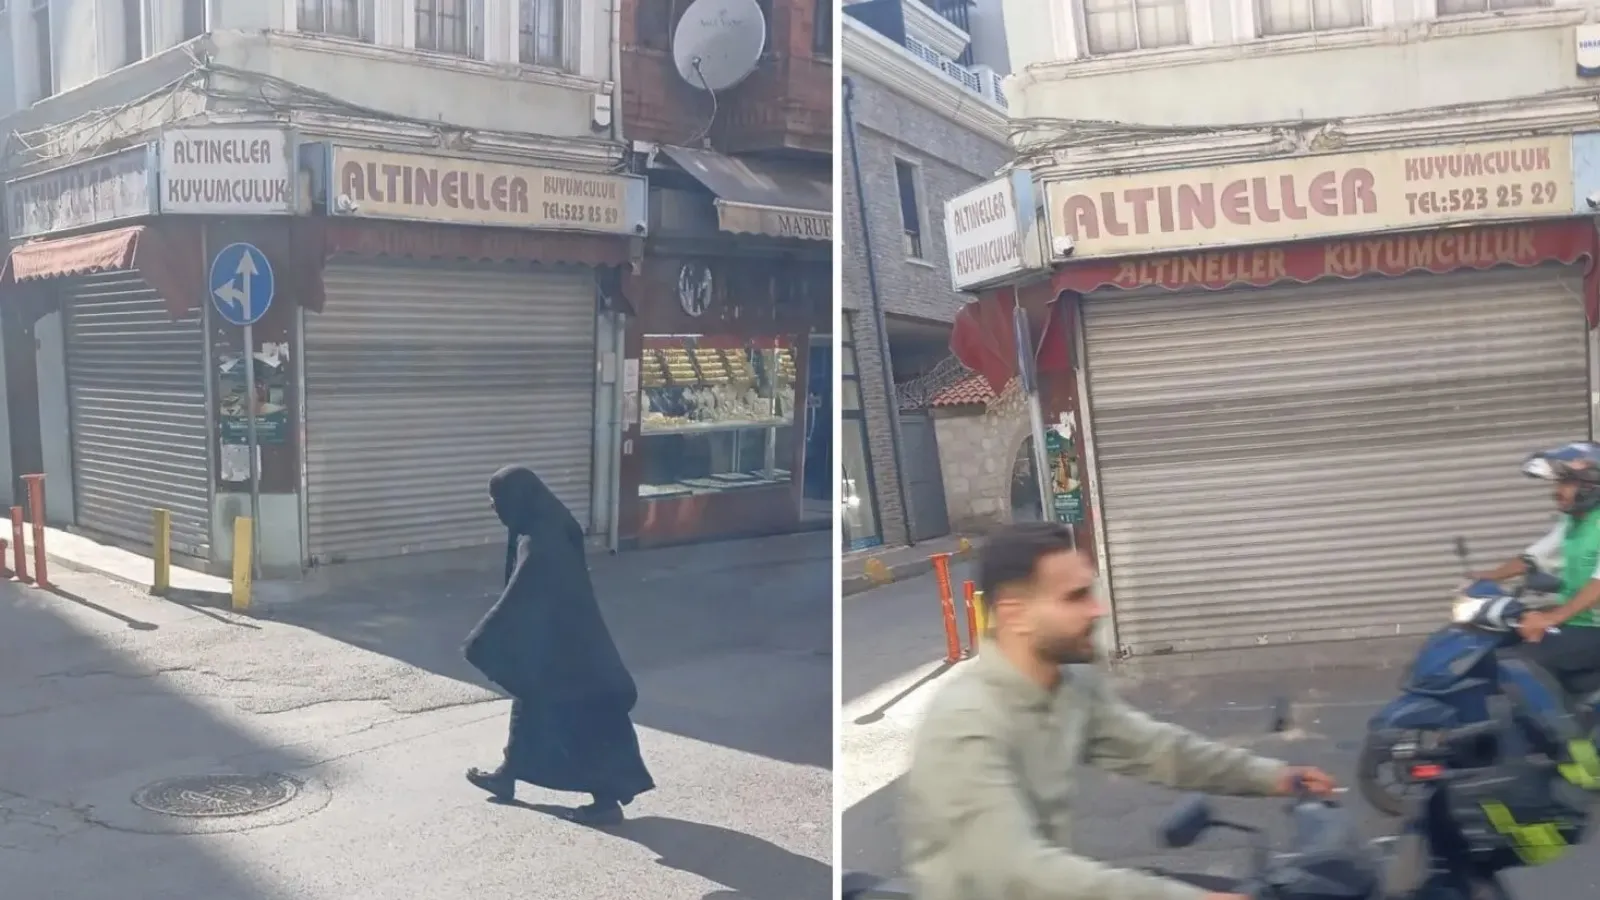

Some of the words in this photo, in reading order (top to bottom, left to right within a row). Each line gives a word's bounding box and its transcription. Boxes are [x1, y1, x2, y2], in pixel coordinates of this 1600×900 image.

[173, 139, 271, 164] ALTINELLER
[1404, 147, 1550, 181] KUYUMCULUK
[168, 179, 287, 203] KUYUMCULUK
[339, 161, 529, 213] ALTINELLER
[543, 175, 616, 199] KUYUMCULUK
[1063, 167, 1378, 241] ALTINELLER
[1405, 187, 1489, 215] TEL:523
[1496, 184, 1523, 208] 25
[1531, 180, 1558, 205] 29
[542, 201, 584, 221] TEL:523
[588, 206, 602, 222] 25
[605, 208, 619, 224] 29
[954, 191, 1006, 236] ALTINELLER
[955, 232, 1018, 276] KUYUMCULUK
[1112, 250, 1287, 284] ALTINELLER
[1324, 227, 1537, 275] KUYUMCULUK
